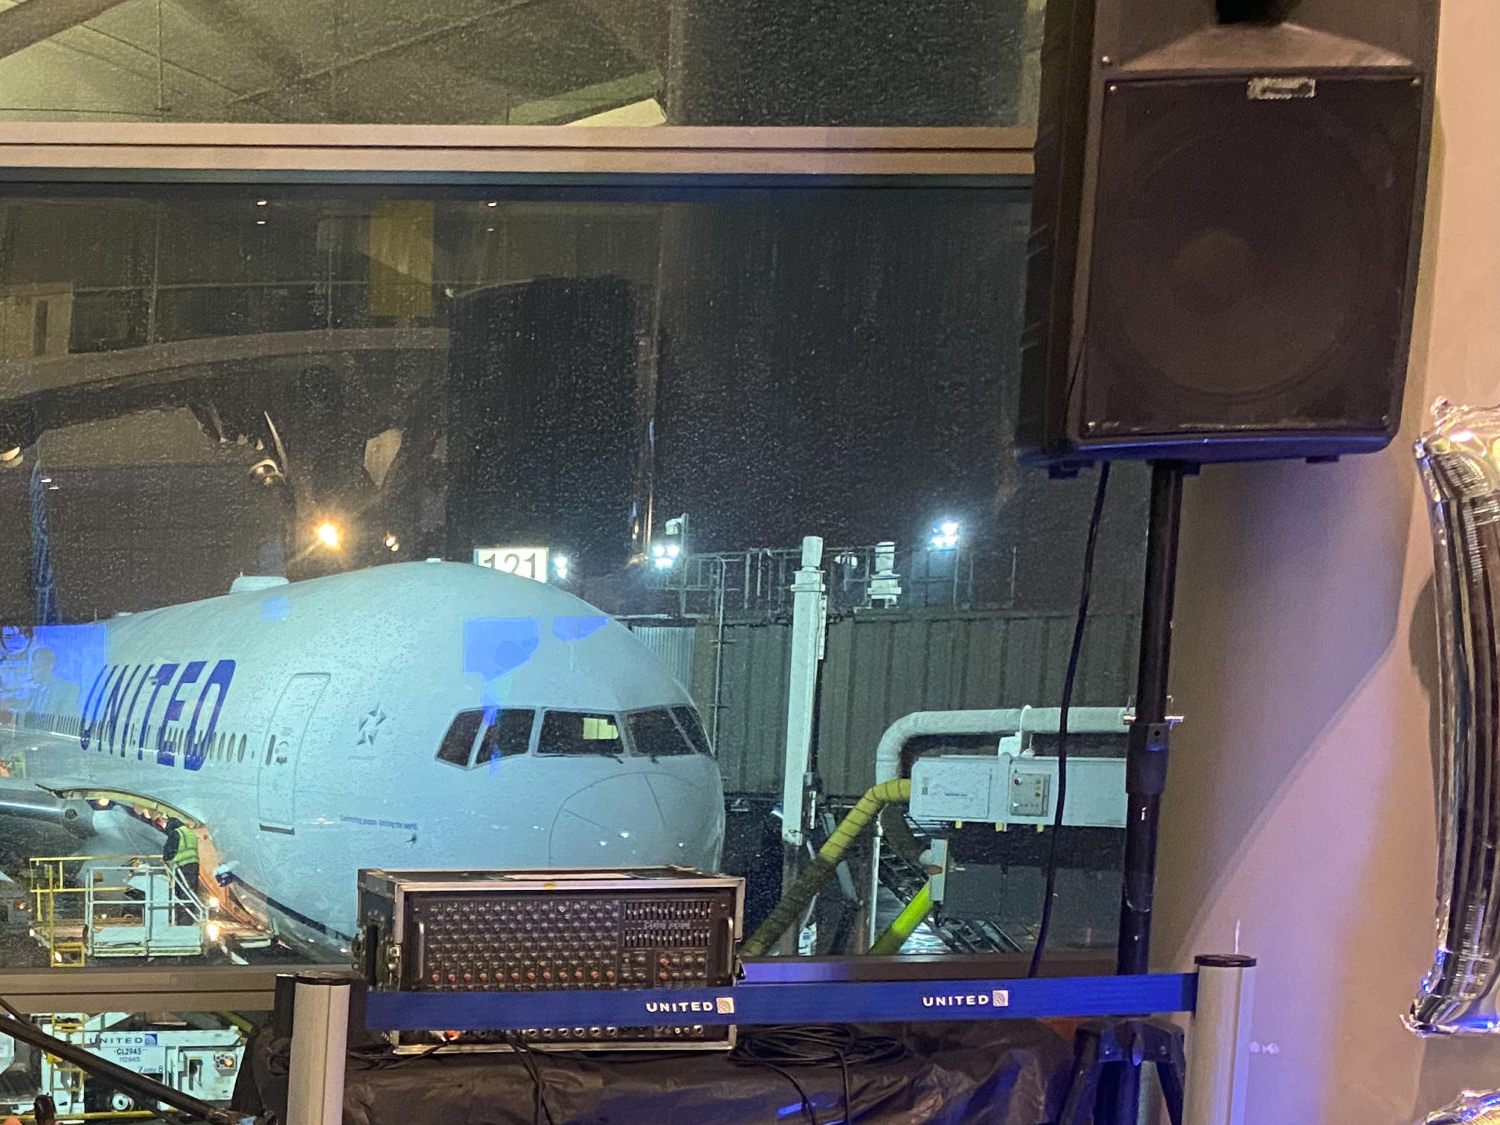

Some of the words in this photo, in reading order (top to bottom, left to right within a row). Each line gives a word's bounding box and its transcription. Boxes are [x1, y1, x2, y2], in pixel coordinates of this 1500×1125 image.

[484, 553, 535, 578] 121
[80, 660, 236, 771] UNITED
[646, 1002, 713, 1013] UNITED
[923, 995, 989, 1006] UNITED
